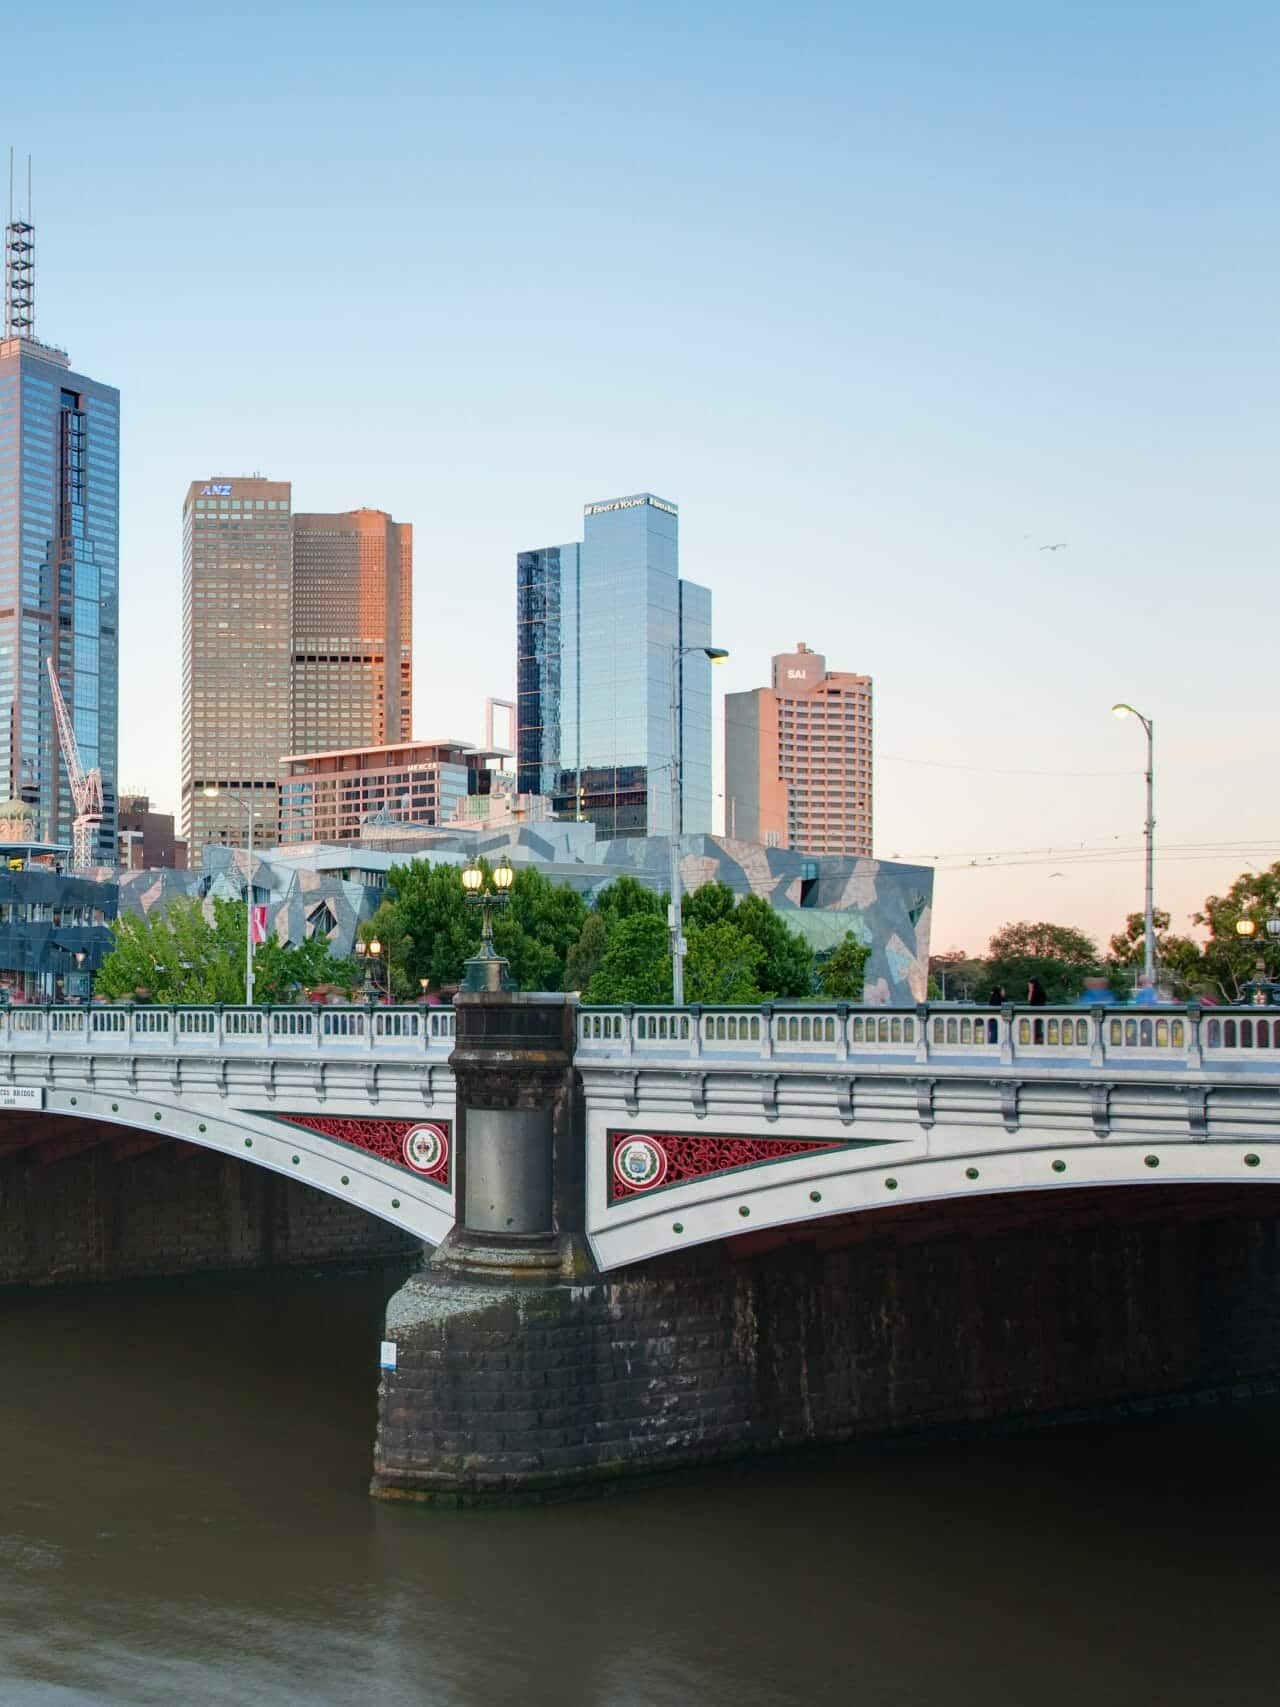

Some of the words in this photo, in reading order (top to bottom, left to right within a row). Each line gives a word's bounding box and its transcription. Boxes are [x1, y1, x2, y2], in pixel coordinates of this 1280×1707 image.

[200, 484, 232, 496] ANZ
[620, 498, 646, 509] YOUNG
[407, 762, 437, 771] MERCER
[13, 1088, 35, 1096] BRIDGE
